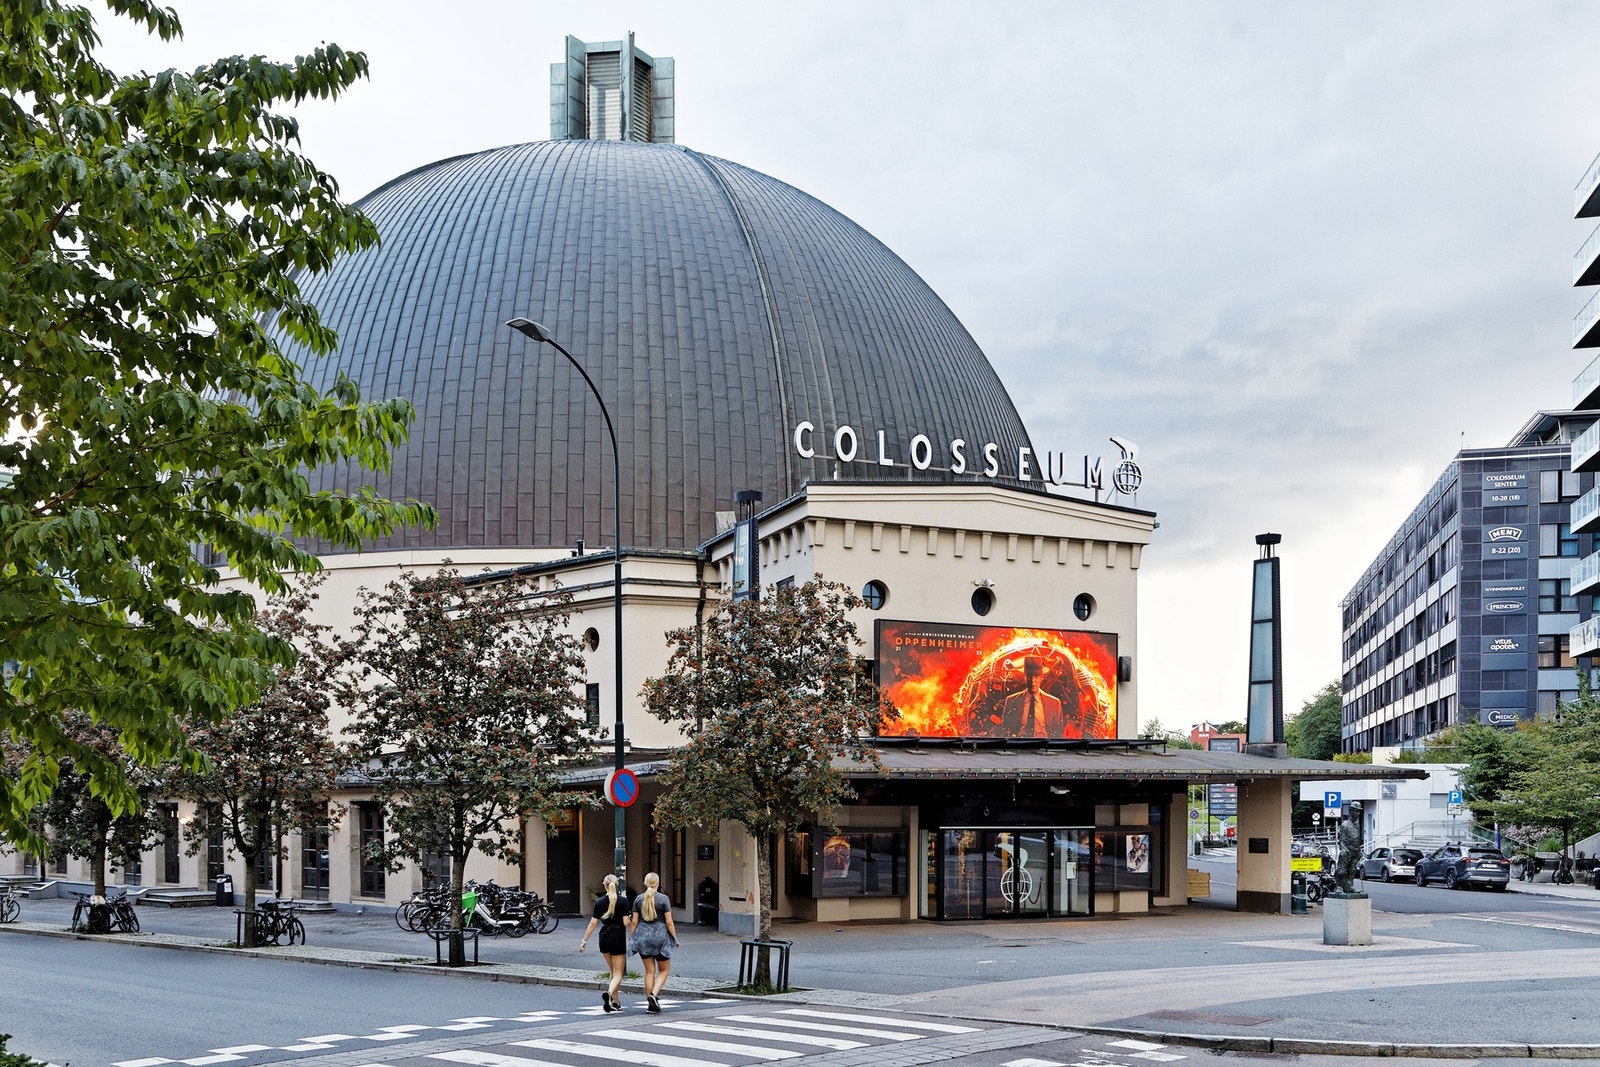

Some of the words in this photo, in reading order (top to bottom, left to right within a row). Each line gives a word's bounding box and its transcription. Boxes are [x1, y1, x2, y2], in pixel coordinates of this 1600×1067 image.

[794, 420, 1105, 491] COLOSSEUM
[1486, 474, 1526, 482] COLOSSEUM
[1491, 528, 1519, 538] MENY
[1507, 546, 1521, 554] (20)
[895, 637, 983, 650] OPPENHEIMER
[1490, 643, 1517, 651] apotek
[1328, 793, 1338, 807] P
[1451, 792, 1460, 802] P
